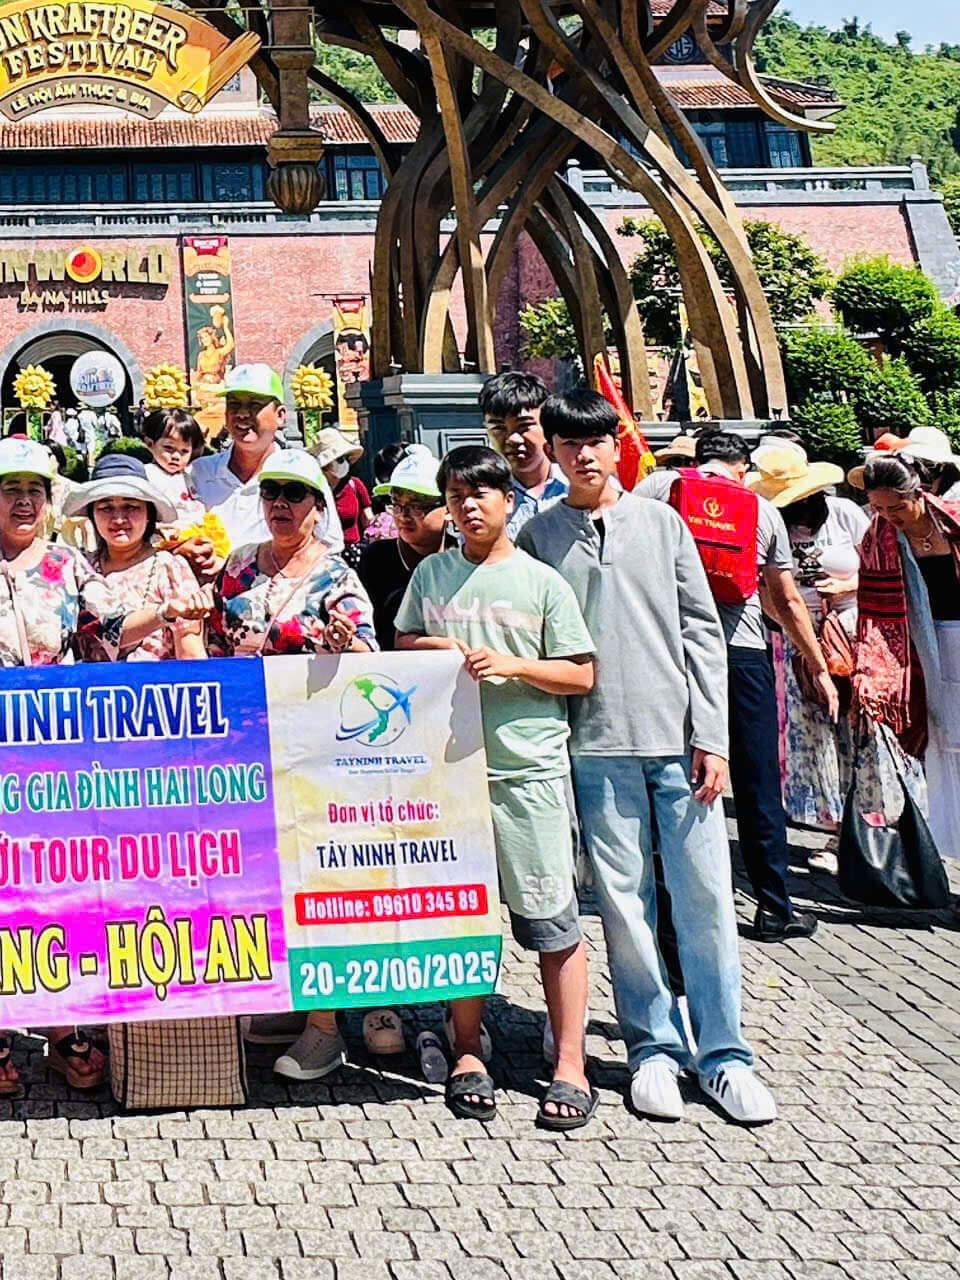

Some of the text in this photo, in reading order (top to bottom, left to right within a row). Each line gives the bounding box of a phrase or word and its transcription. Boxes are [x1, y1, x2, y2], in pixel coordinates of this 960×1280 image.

[25, 3, 187, 72] KRAFTBEER
[1, 38, 159, 79] FESTIVAL
[130, 91, 152, 111] BIA
[29, 246, 172, 285] WORLD
[71, 289, 110, 305] HILLS
[87, 683, 228, 742] TRAVEL
[384, 755, 427, 765] TRAVEL
[27, 771, 72, 811] GIA
[77, 762, 140, 809] ĐÌNH
[145, 766, 190, 806] HAI
[195, 763, 266, 804] LONG
[328, 802, 357, 823] Đơn
[360, 801, 375, 827] vị
[379, 795, 394, 823] tổ
[29, 835, 111, 884] TOUR
[119, 834, 160, 880] DU
[168, 830, 241, 887] LỊCH
[316, 839, 457, 868] TÂY NINH TRAVEL
[304, 889, 479, 919] Hotline: 09610 345 89
[80, 952, 98, 977] -
[105, 905, 196, 1001] HỘI
[204, 915, 272, 983] AN
[300, 950, 497, 997] 20-22/06/2025
